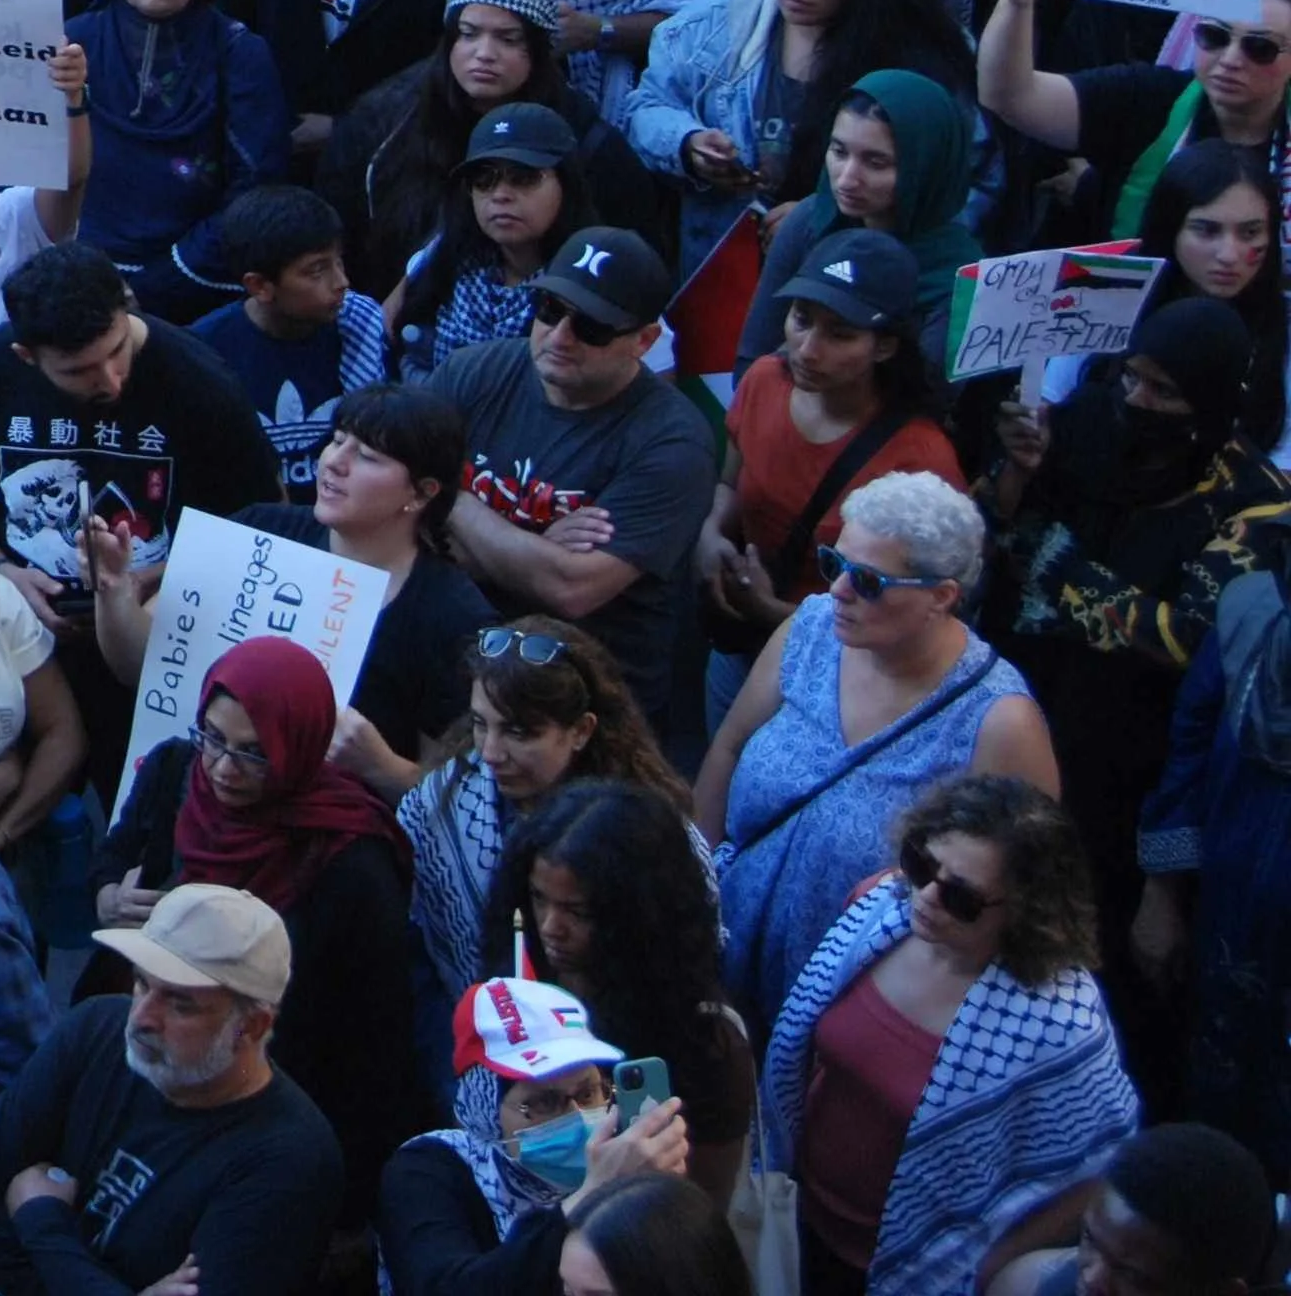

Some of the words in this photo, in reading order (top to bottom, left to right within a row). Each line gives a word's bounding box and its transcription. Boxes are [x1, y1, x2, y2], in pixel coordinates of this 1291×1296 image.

[7, 416, 166, 452] 暴動社会
[217, 535, 277, 645] lineages
[146, 589, 200, 718] Babies
